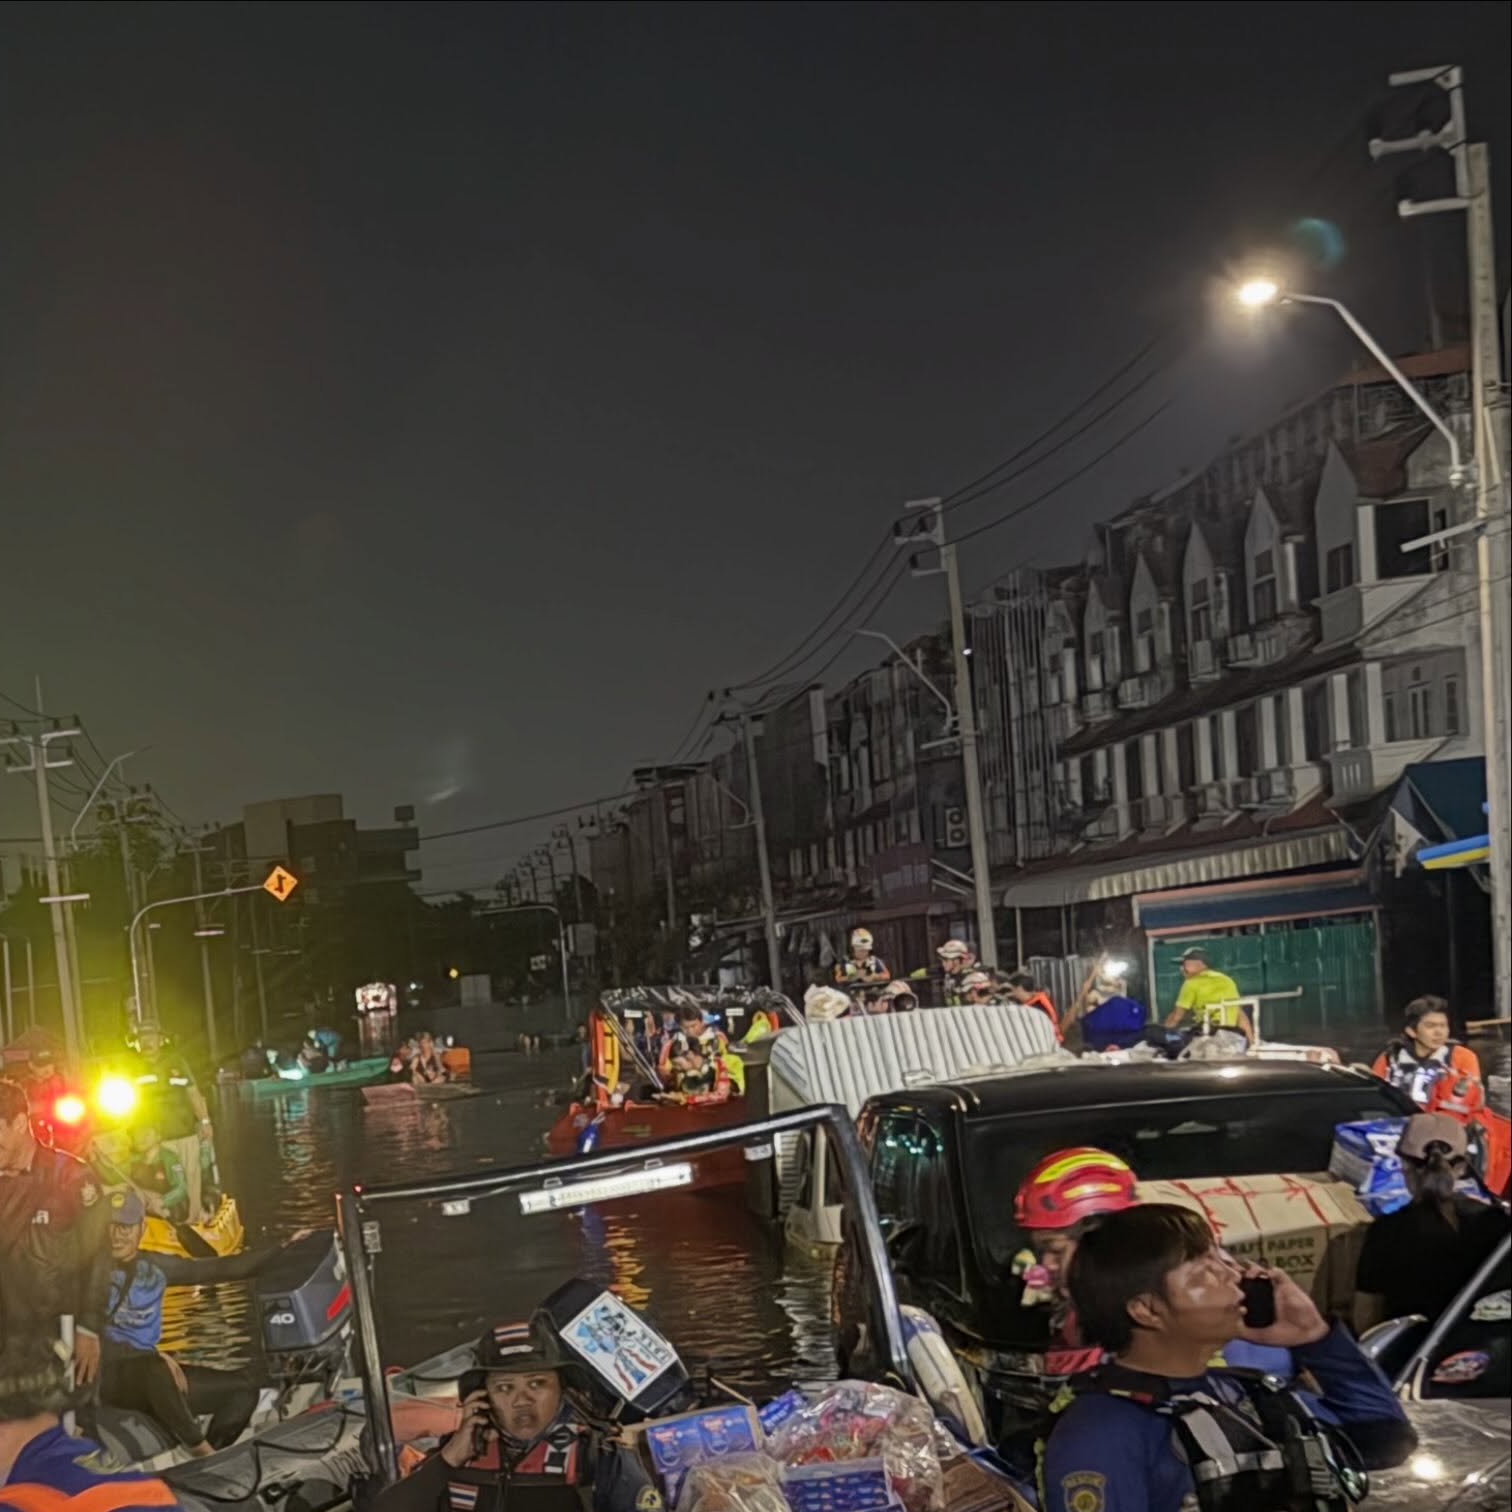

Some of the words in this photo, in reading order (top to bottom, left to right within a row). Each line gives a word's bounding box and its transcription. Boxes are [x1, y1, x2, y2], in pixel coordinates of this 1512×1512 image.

[1268, 1236, 1315, 1251] PAPER
[1274, 1253, 1314, 1269] BOX
[269, 1313, 295, 1326] 40
